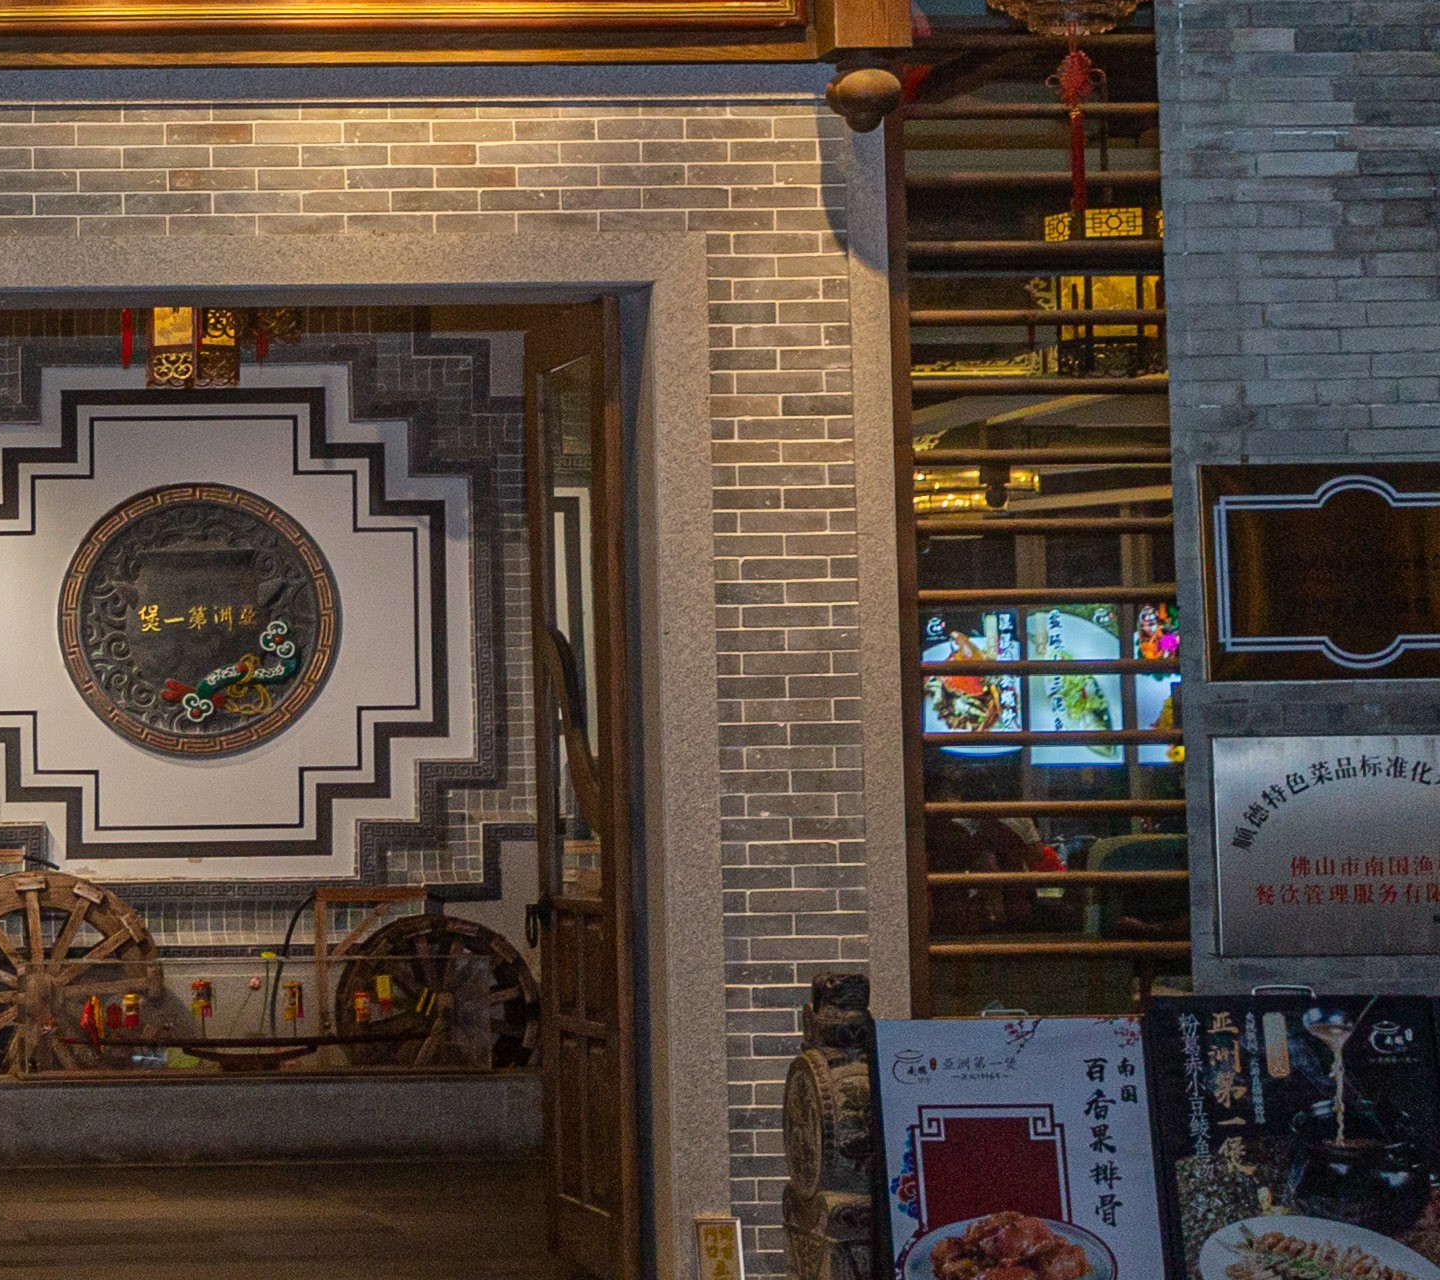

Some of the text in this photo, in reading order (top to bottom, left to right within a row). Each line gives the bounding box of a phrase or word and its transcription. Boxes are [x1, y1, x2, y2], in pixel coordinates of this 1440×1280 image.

[1083, 1057, 1123, 1227] 百香果排骨
